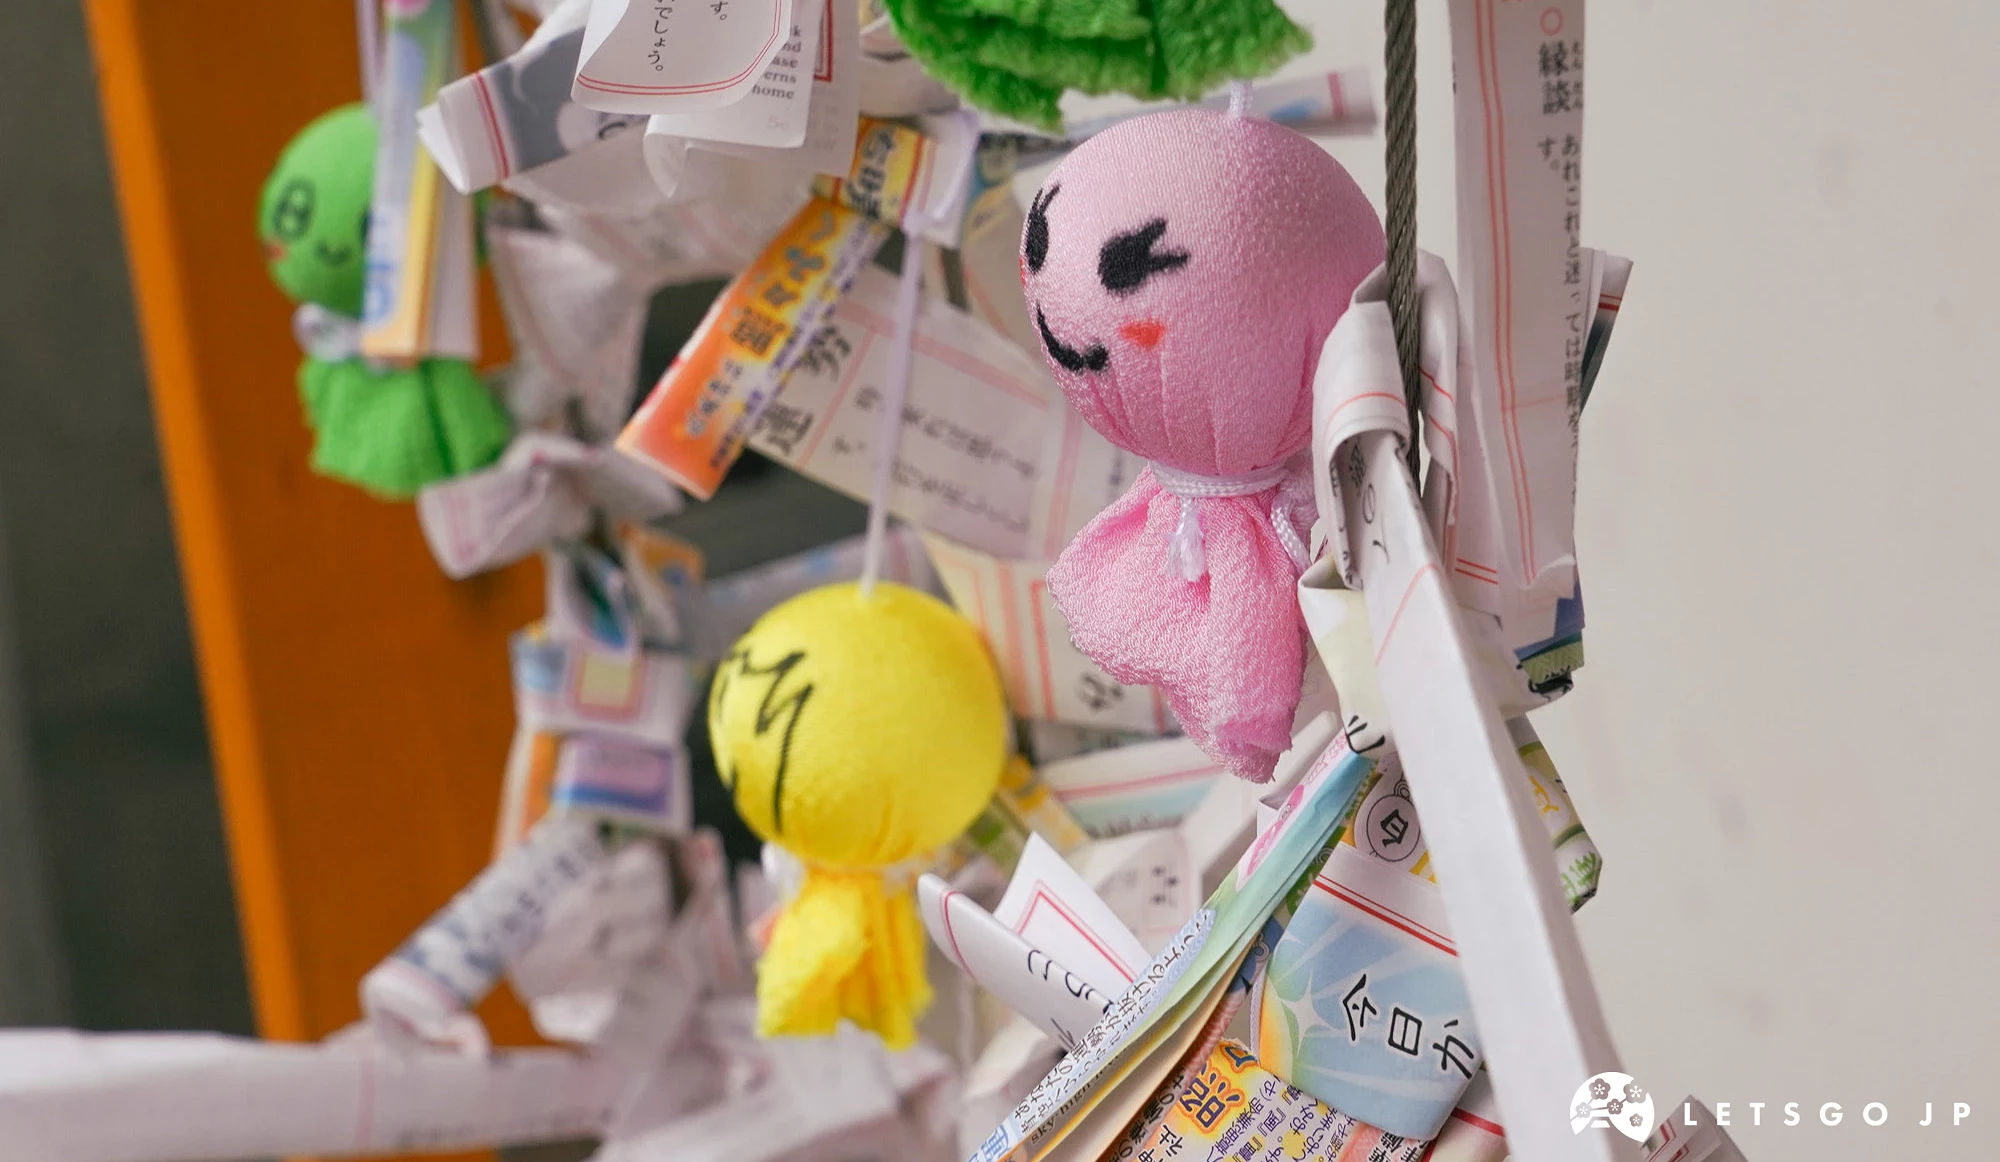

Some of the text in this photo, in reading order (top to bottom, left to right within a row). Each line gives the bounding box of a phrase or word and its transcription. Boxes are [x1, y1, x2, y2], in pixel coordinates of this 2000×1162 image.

[647, 0, 674, 72] でしょう。
[751, 83, 795, 100] home
[763, 70, 797, 85] erns
[1379, 808, 1408, 848] 白
[1342, 973, 1474, 1080] 今日か
